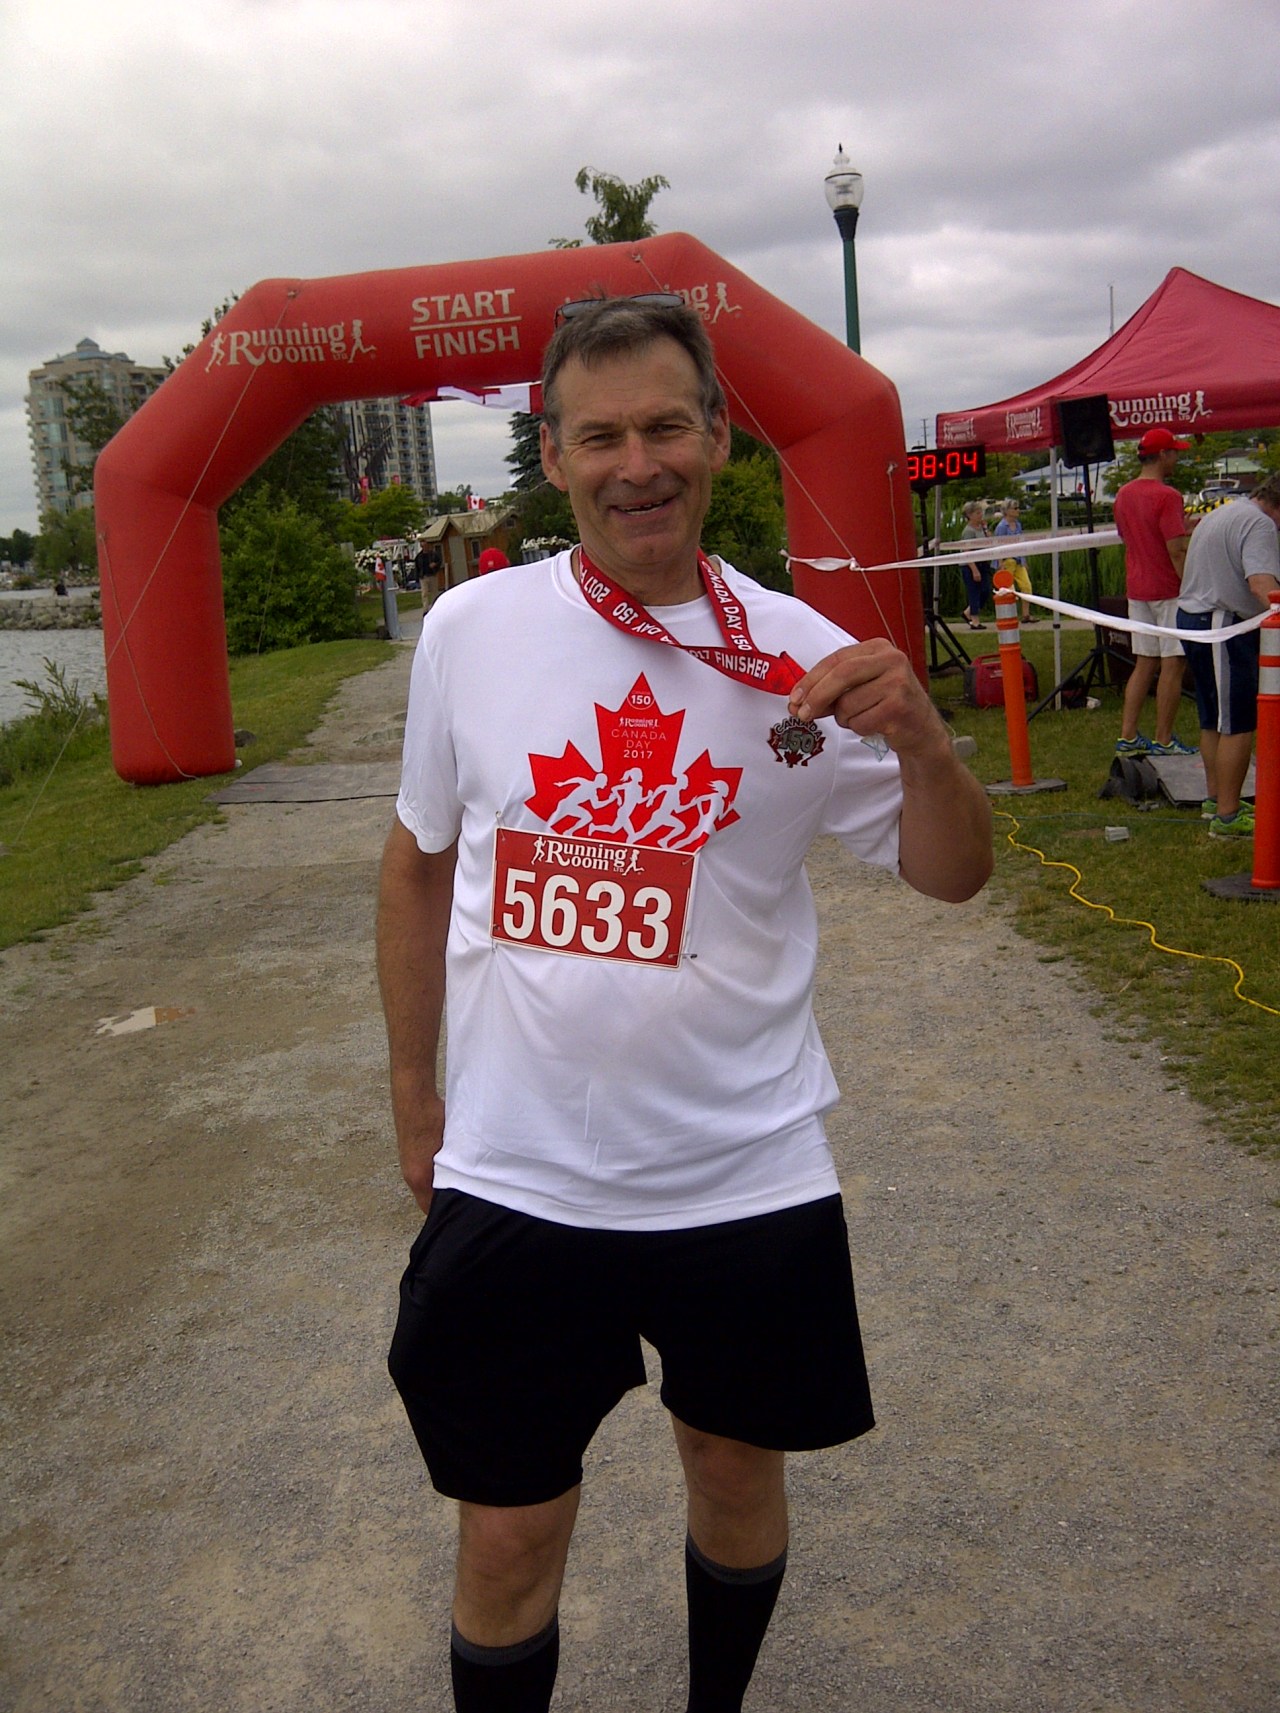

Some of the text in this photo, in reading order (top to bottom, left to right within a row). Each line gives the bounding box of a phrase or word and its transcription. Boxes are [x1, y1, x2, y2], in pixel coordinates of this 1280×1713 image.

[411, 288, 516, 323] START
[227, 321, 346, 366] Running
[414, 326, 520, 359] FINISH
[583, 575, 663, 636] DAY 150 2017
[723, 606, 743, 631] DAY
[730, 634, 753, 651] 150
[714, 651, 770, 681] FINISHER
[631, 694, 651, 705] 150
[611, 728, 667, 741] CANADA
[626, 739, 651, 749] DAY
[779, 730, 816, 754] 150
[623, 749, 653, 760] 2017
[545, 840, 628, 868] Running
[502, 867, 673, 960] 5633
